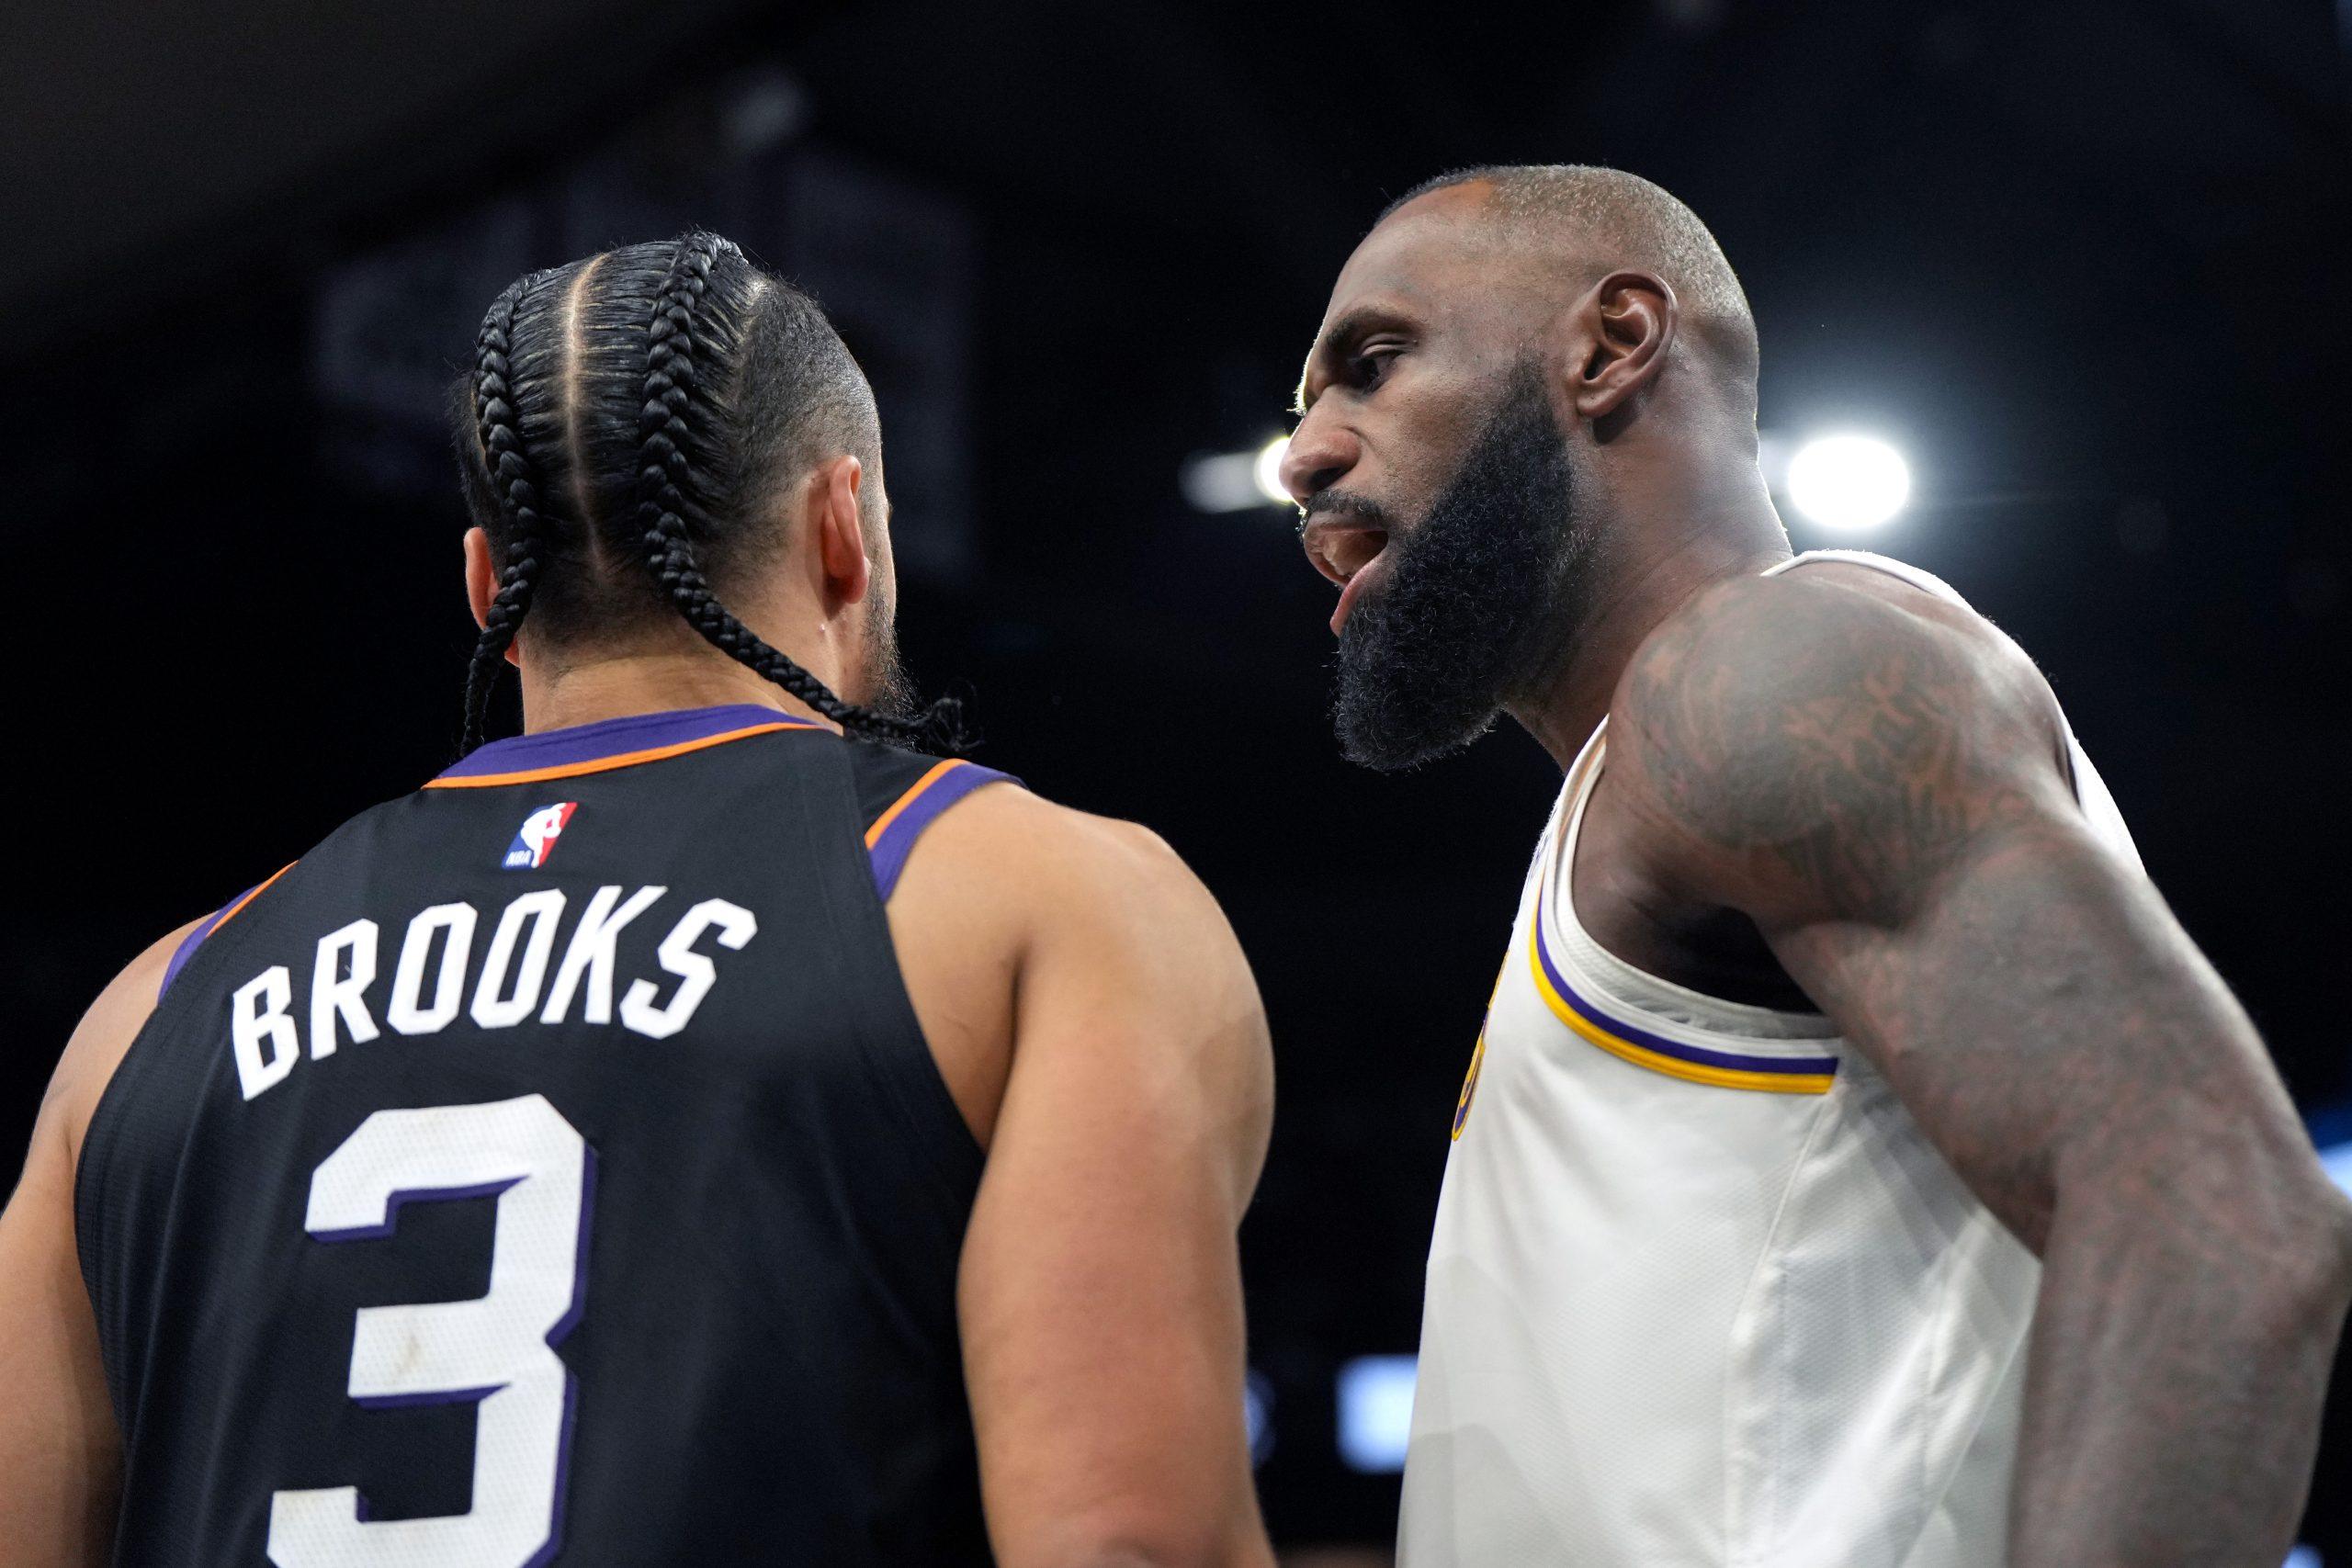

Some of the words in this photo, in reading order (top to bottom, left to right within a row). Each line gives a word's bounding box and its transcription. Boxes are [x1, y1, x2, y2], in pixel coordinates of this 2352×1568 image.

[505, 850, 533, 866] NBA
[232, 886, 758, 1101] BROOKS
[266, 1093, 595, 1568] 3
